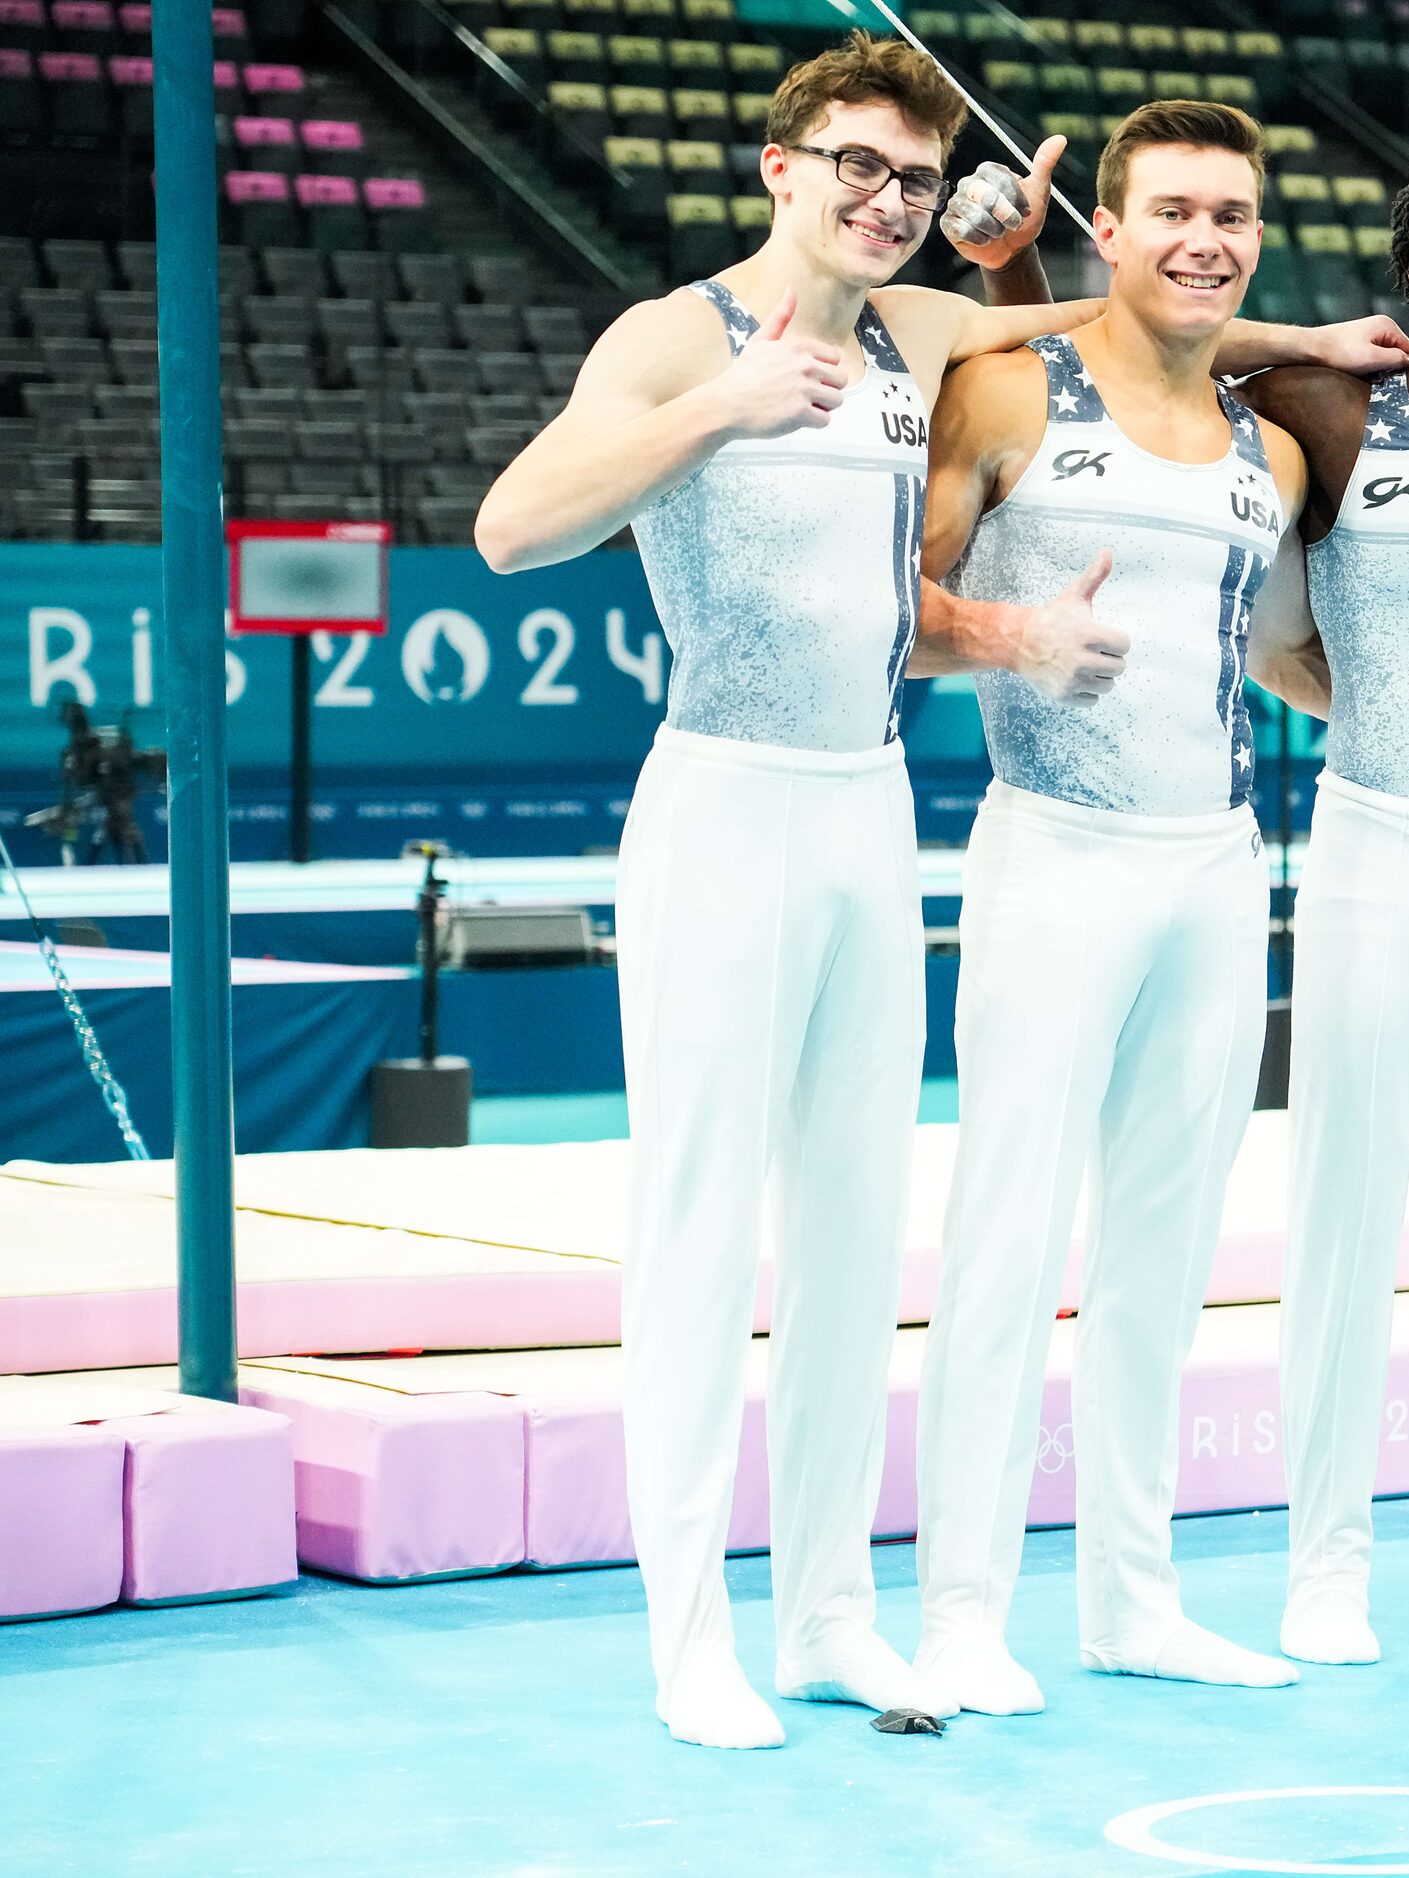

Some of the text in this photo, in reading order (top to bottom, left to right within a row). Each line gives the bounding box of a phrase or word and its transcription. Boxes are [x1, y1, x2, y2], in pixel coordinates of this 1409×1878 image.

[880, 410, 929, 449] USA
[1229, 491, 1280, 539] USA
[310, 607, 664, 706] 2024
